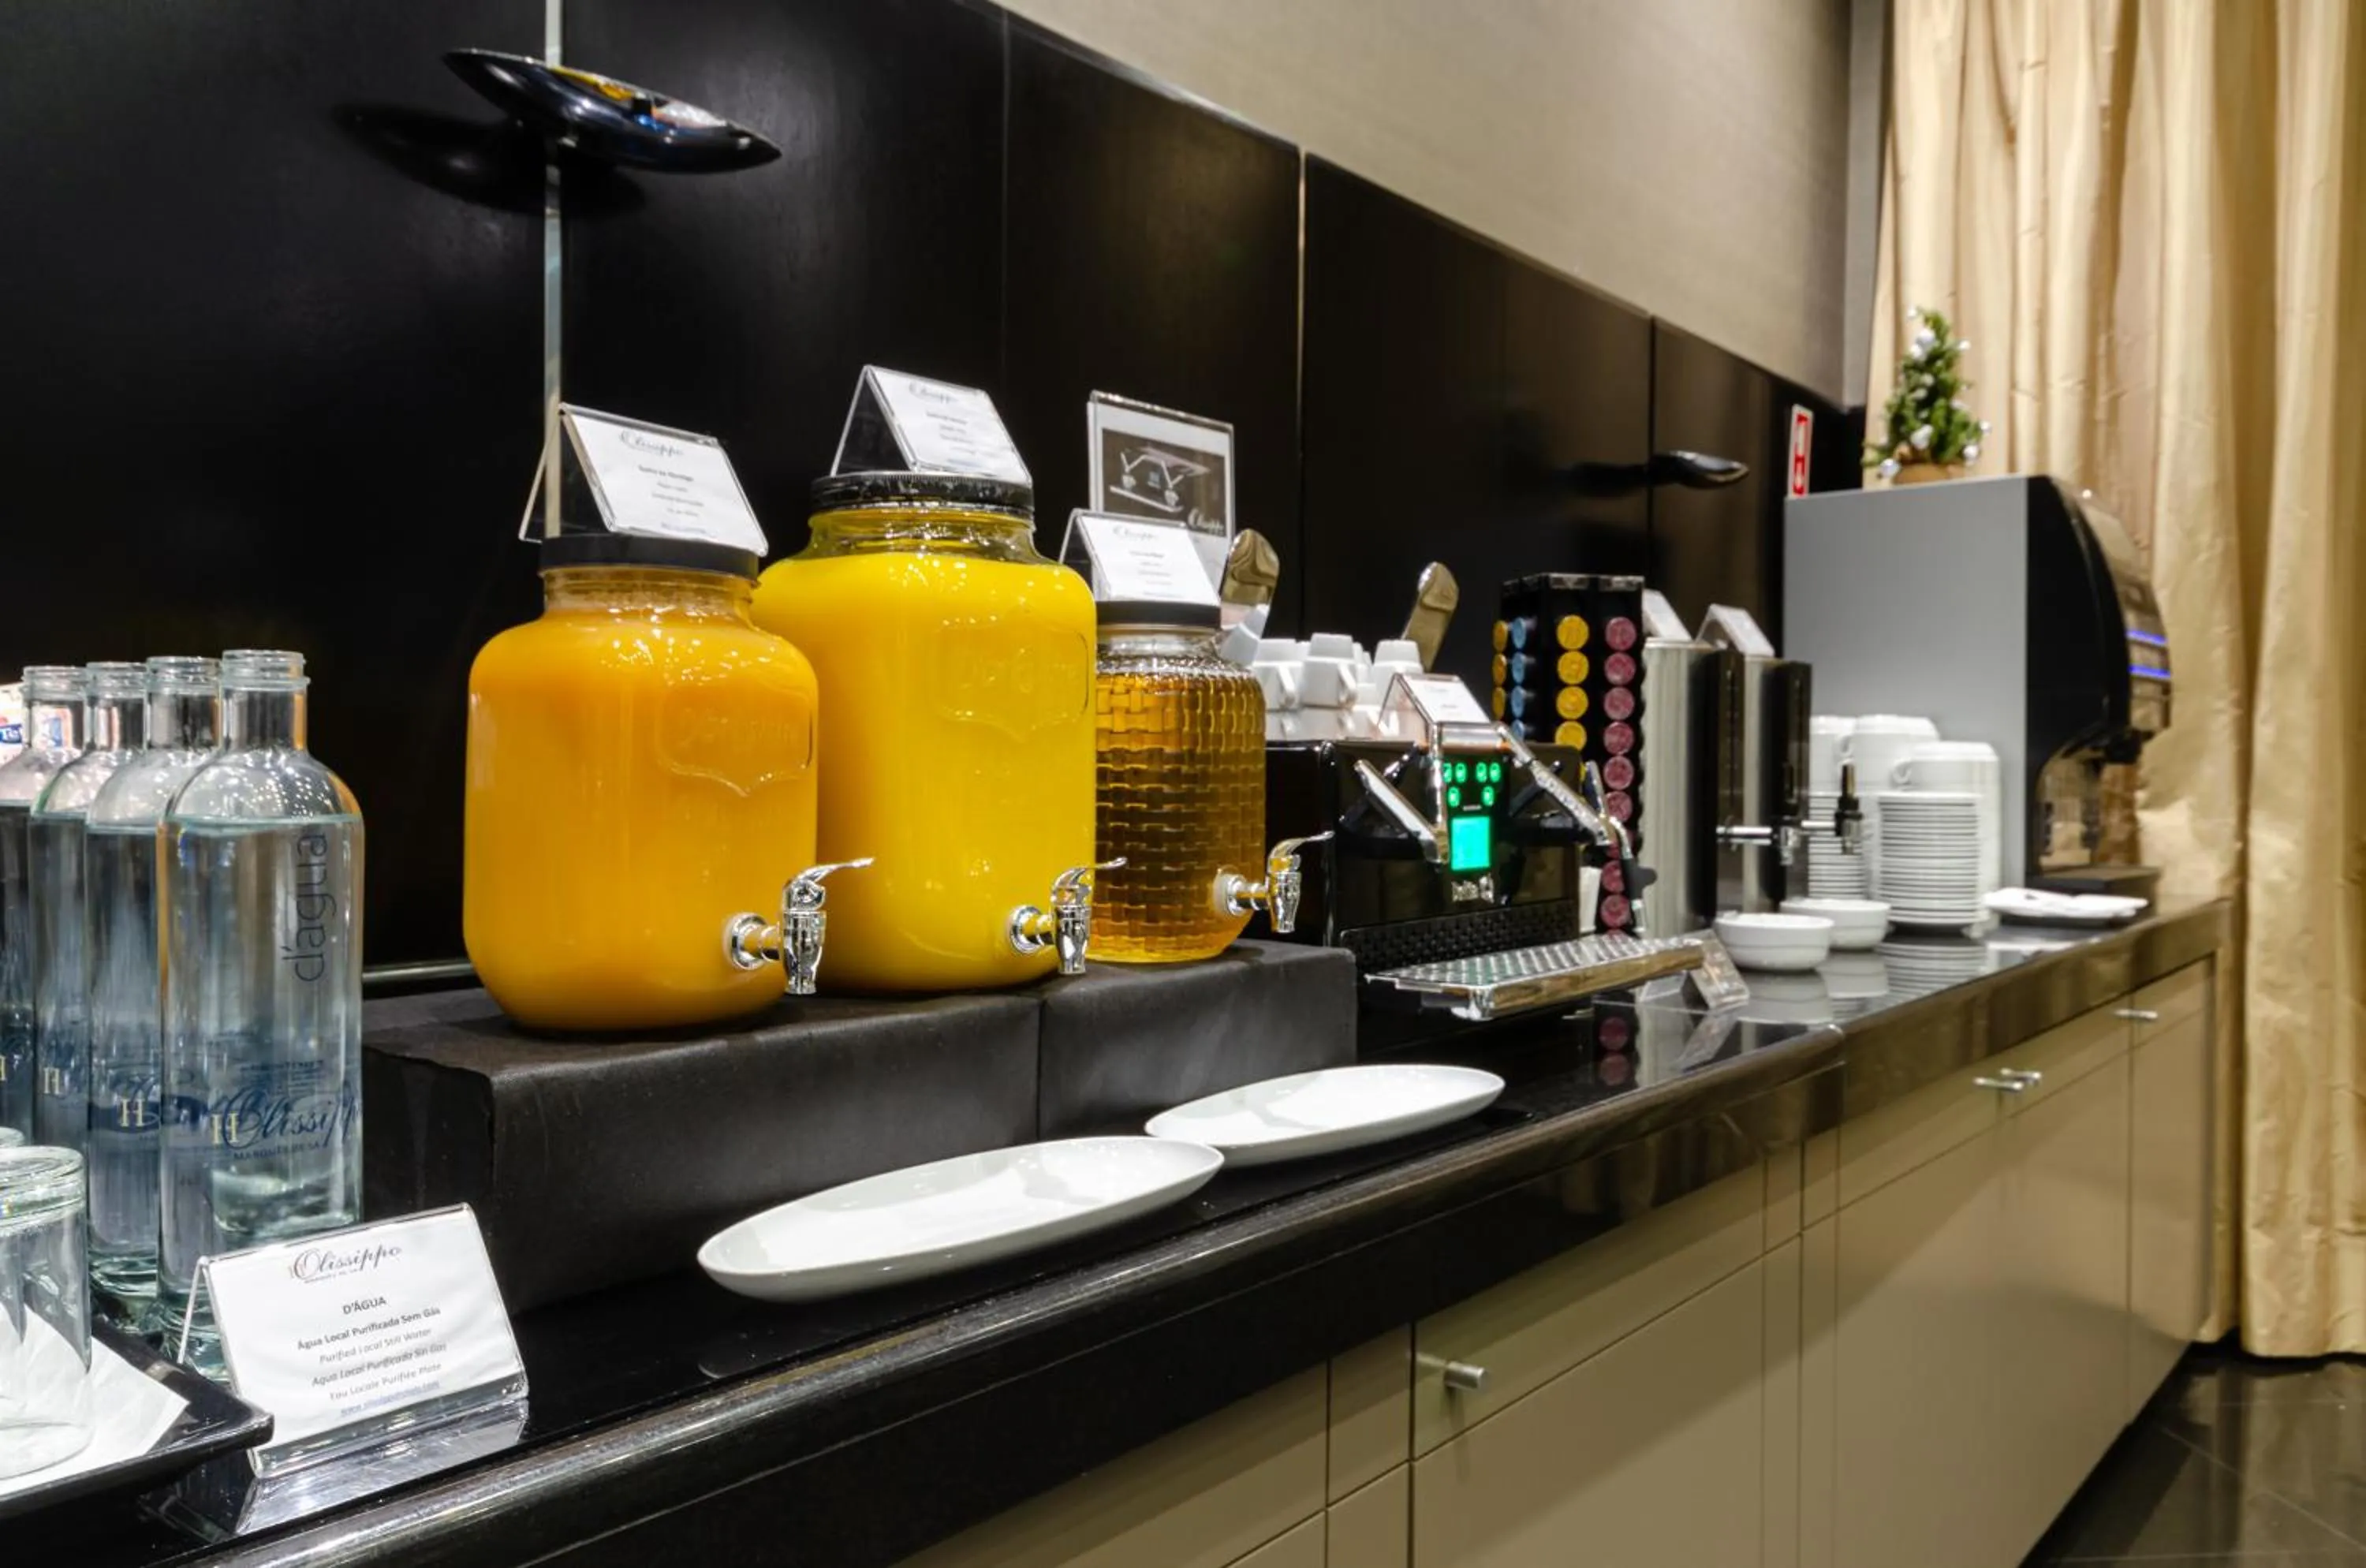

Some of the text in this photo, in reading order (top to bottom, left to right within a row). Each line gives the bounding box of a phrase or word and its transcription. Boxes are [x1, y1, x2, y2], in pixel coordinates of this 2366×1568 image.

[293, 1243, 403, 1282] Olissippo
[342, 1296, 387, 1316] D'ÁGUA
[324, 1328, 350, 1345] Local
[352, 1316, 400, 1338] Purificada
[401, 1312, 422, 1325] Sem
[319, 1348, 357, 1364] Purified
[359, 1339, 383, 1354] Local
